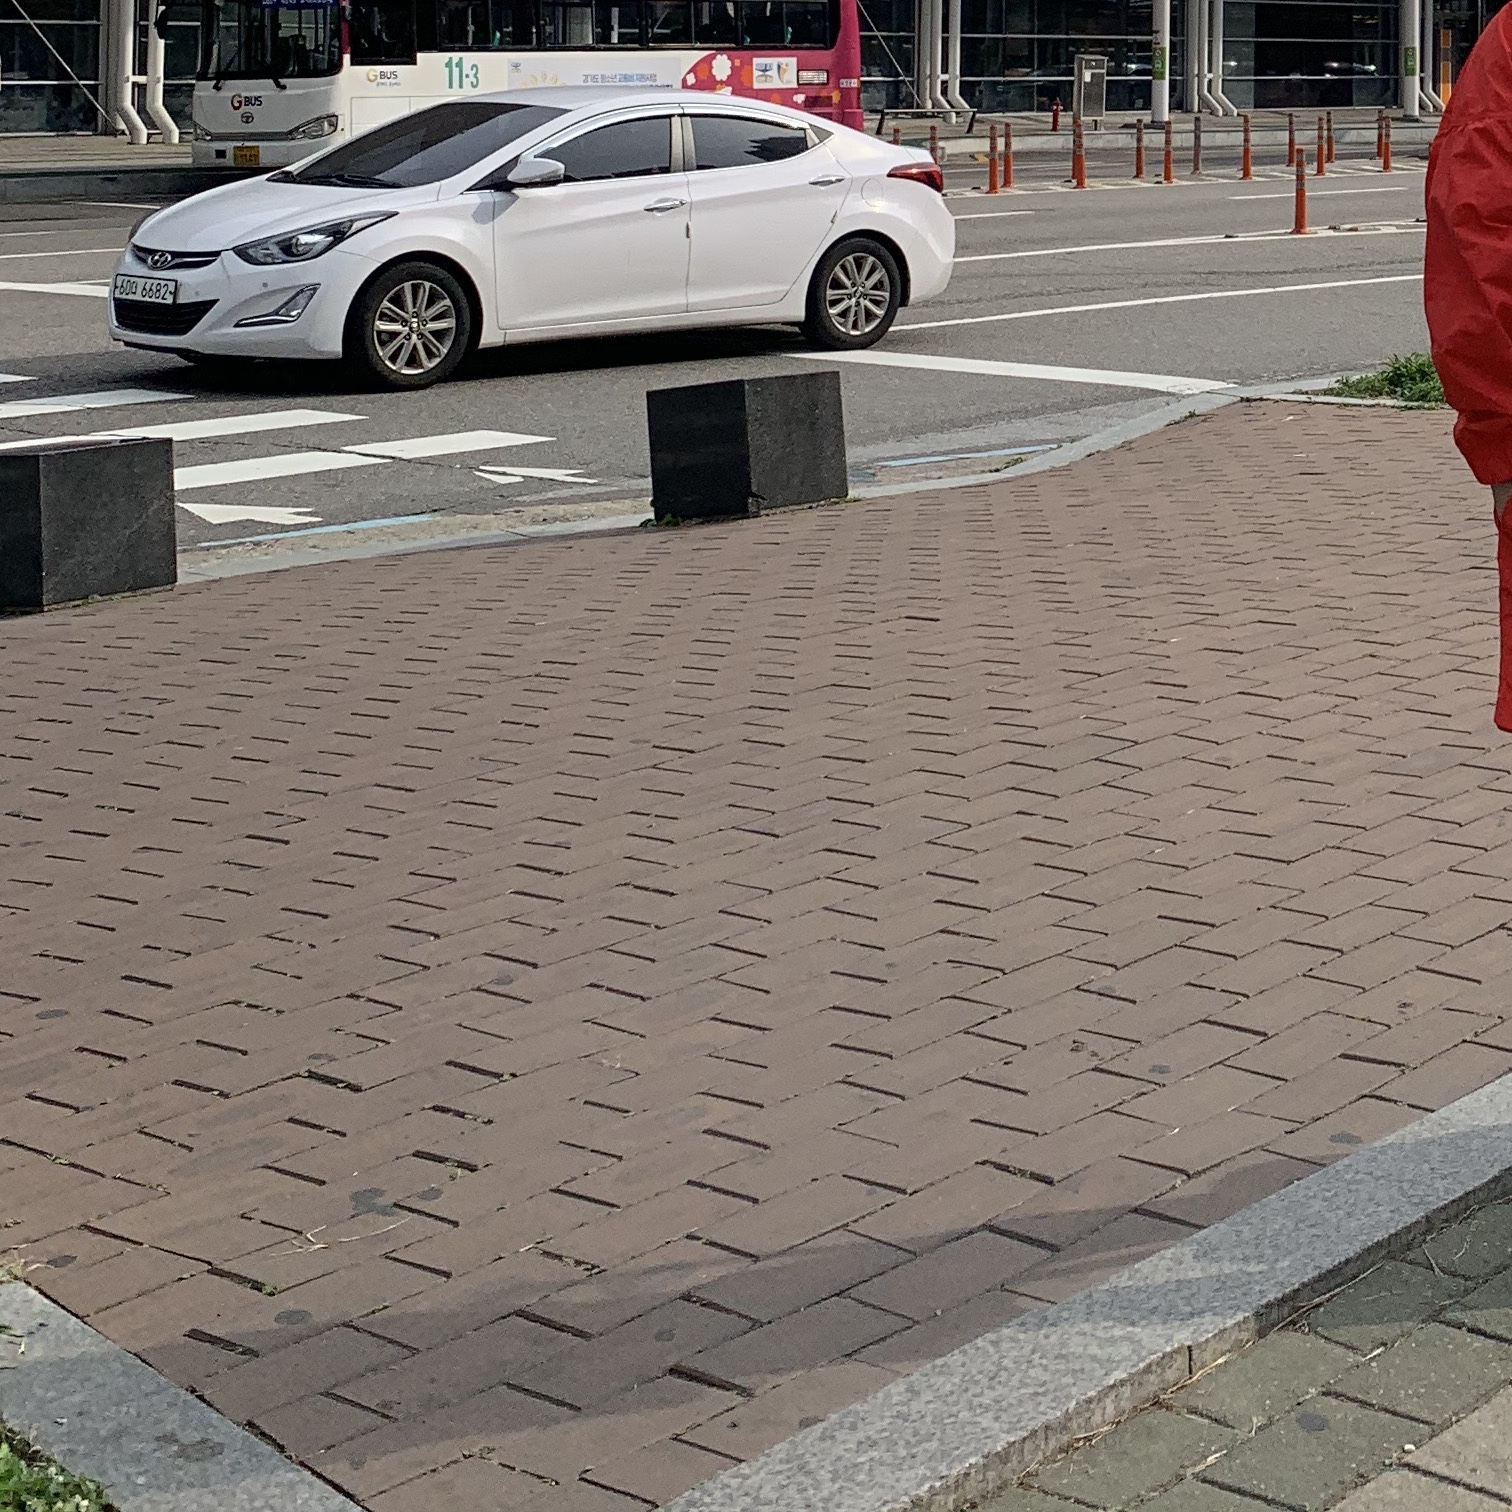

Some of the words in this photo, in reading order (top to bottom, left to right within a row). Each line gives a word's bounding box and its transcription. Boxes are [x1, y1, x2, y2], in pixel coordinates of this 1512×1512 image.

[380, 71, 398, 79] BUS
[244, 96, 262, 106] BUS
[141, 282, 169, 300] 6682
